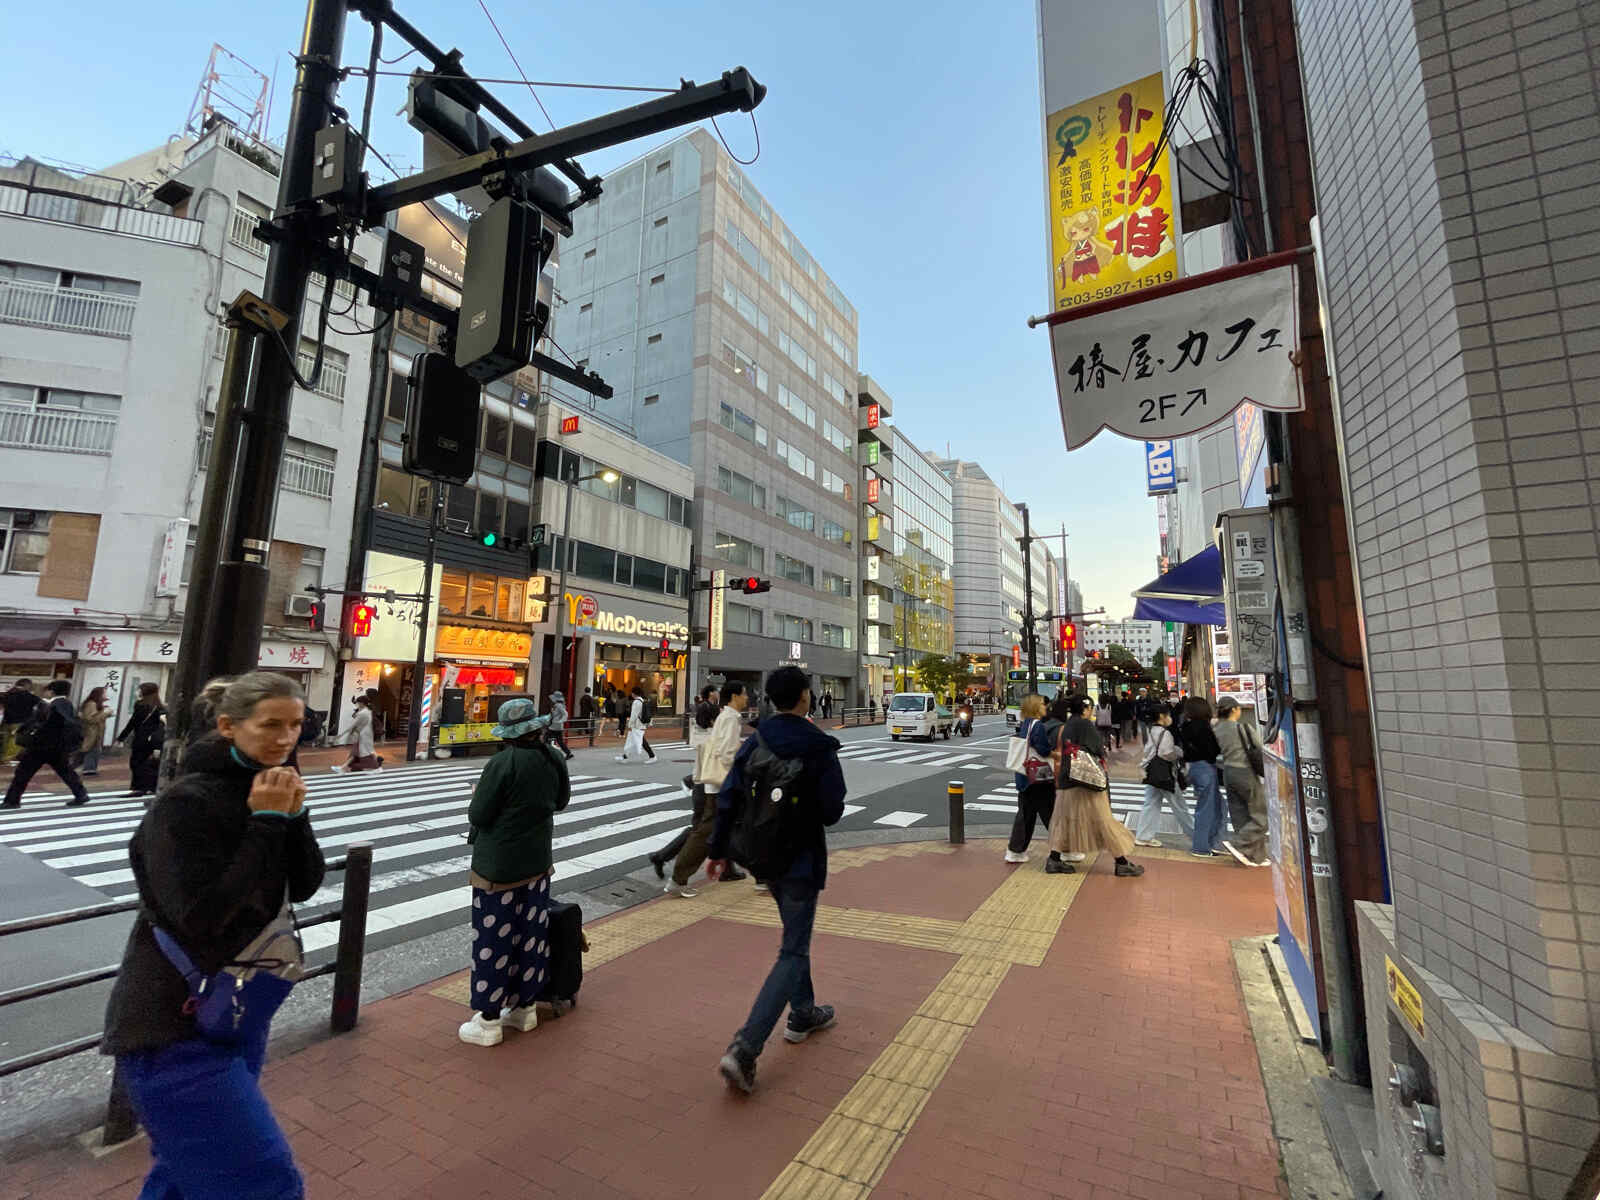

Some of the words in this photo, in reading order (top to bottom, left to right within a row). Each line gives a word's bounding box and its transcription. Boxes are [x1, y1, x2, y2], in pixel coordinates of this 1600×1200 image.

[1059, 166, 1073, 211] 激安販売
[1079, 159, 1093, 203] 高価買取
[1073, 270, 1173, 305] 03-5927-1519
[1139, 394, 1177, 424] 2F
[597, 610, 689, 641] McDonald's
